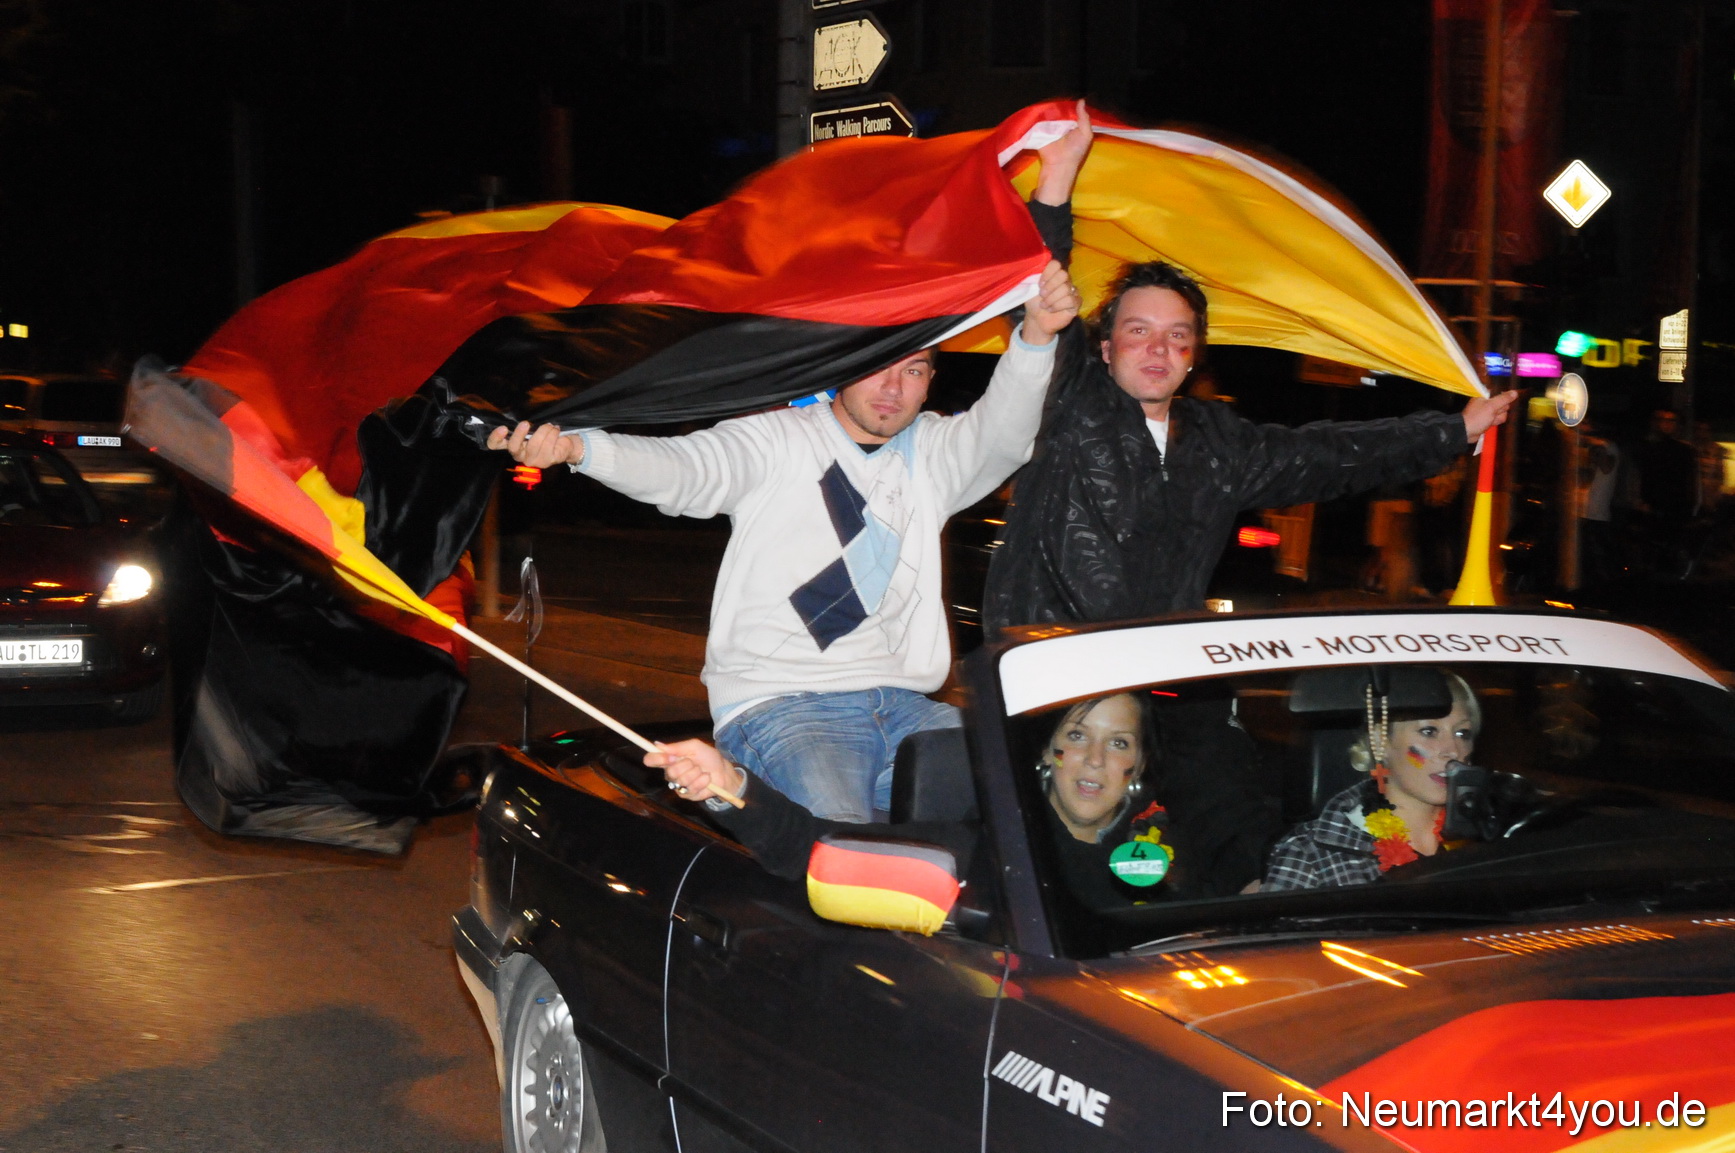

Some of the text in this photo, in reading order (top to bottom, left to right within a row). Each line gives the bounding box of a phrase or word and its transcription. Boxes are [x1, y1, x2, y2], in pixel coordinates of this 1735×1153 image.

[814, 116, 892, 140] Nordic Walking Parcours
[28, 644, 47, 660] TL
[52, 644, 80, 660] 219
[1201, 640, 1294, 664] BMW
[1314, 634, 1570, 657] MOTORSPORT
[1130, 843, 1147, 859] 4
